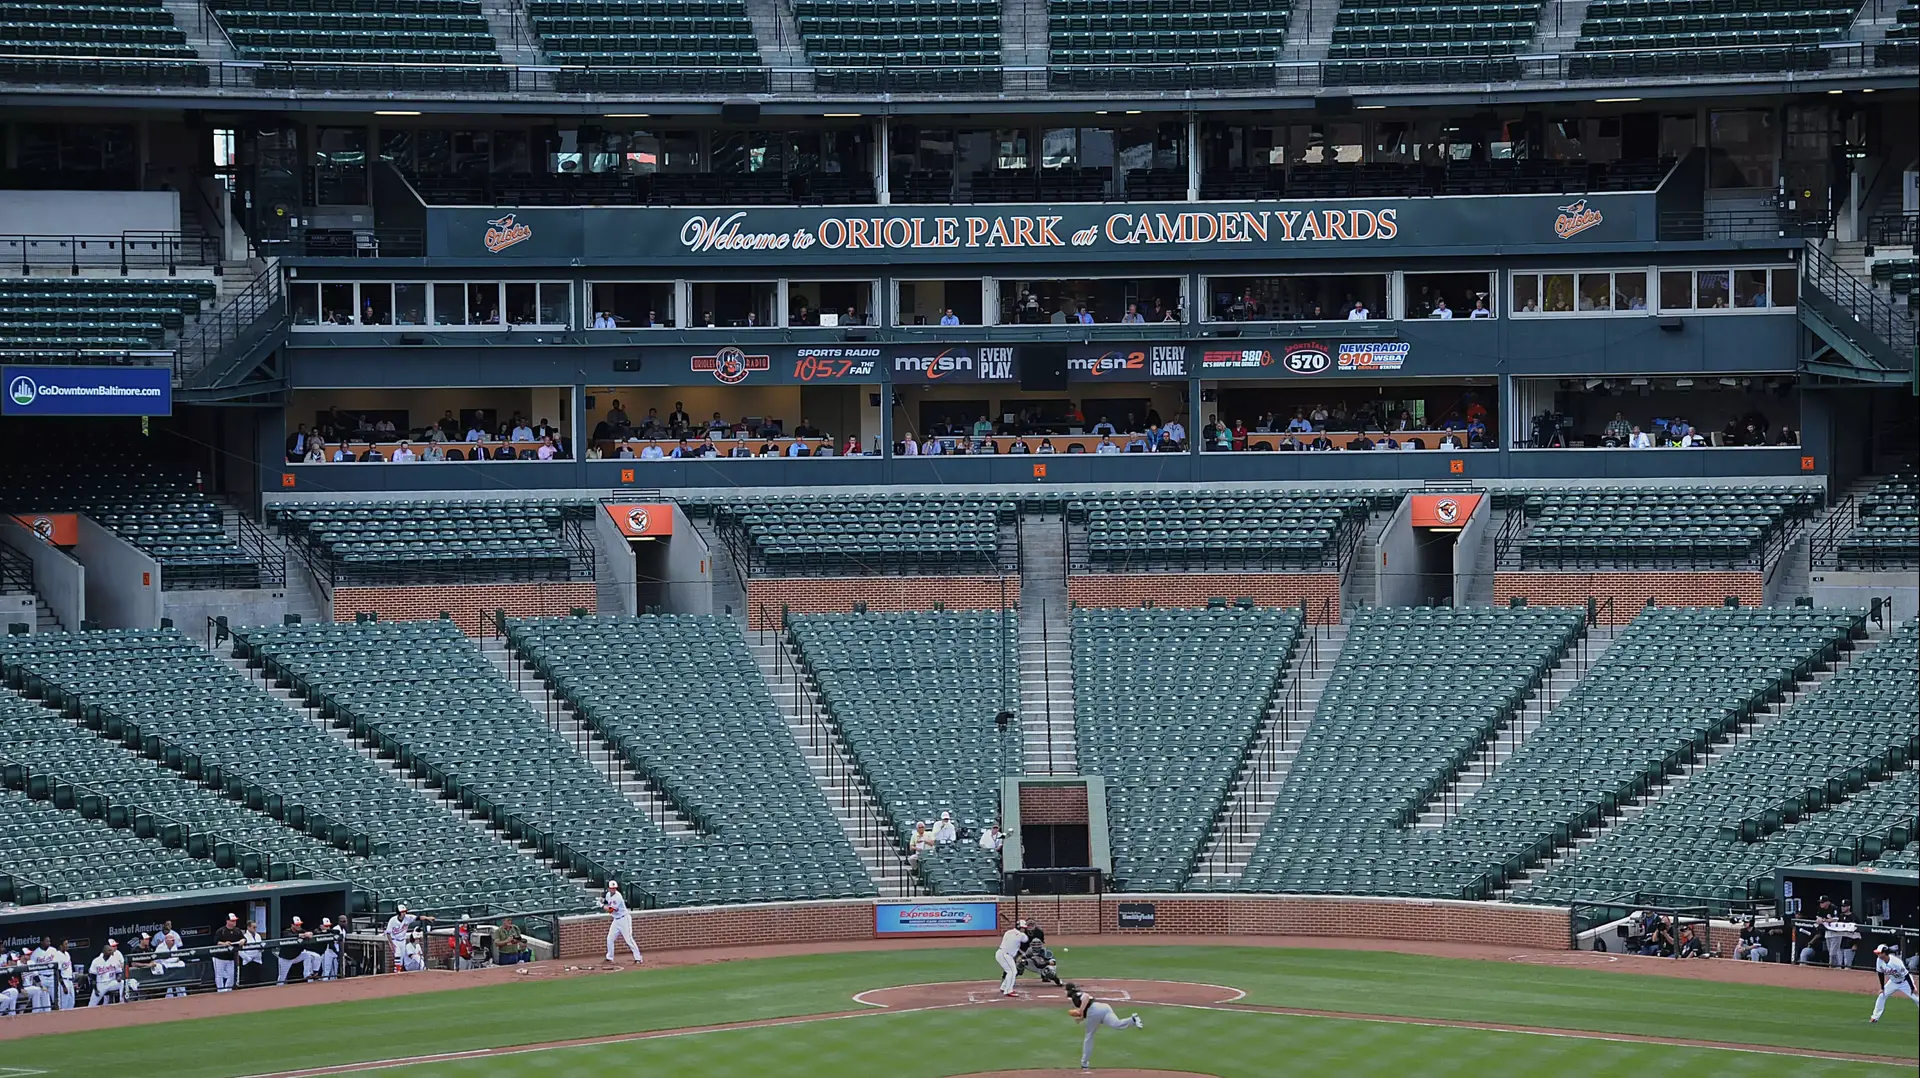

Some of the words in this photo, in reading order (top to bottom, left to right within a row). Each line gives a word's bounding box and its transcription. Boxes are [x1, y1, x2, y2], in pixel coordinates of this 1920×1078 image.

[680, 211, 789, 251] Welcome
[788, 228, 816, 250] to
[818, 217, 960, 249] ORIOLE
[965, 215, 1065, 248] PARK
[1071, 224, 1098, 247] at
[1104, 211, 1271, 244] CAMDEN
[1275, 208, 1398, 241] YARDS
[1555, 209, 1603, 236] Orioles
[484, 223, 532, 250] Orioles
[797, 349, 842, 357] SPORTS
[980, 347, 1013, 361] EVERY
[1153, 346, 1186, 360] EVERY
[1339, 343, 1410, 353] NEWSRADIO
[746, 358, 767, 367] RADIO
[1203, 351, 1242, 361] ESPN
[1241, 350, 1263, 361] 980
[1291, 354, 1325, 369] 570
[1338, 352, 1373, 365] 910
[895, 356, 972, 370] masn
[980, 362, 1013, 378] PLAY.
[1153, 361, 1187, 375] GAME.
[38, 385, 161, 396] GoDowntownBaltimore.com
[900, 910, 965, 919] ExpressCare
[109, 926, 127, 936] Bank
[127, 924, 134, 934] of
[134, 922, 163, 932] America
[11, 935, 41, 946] America
